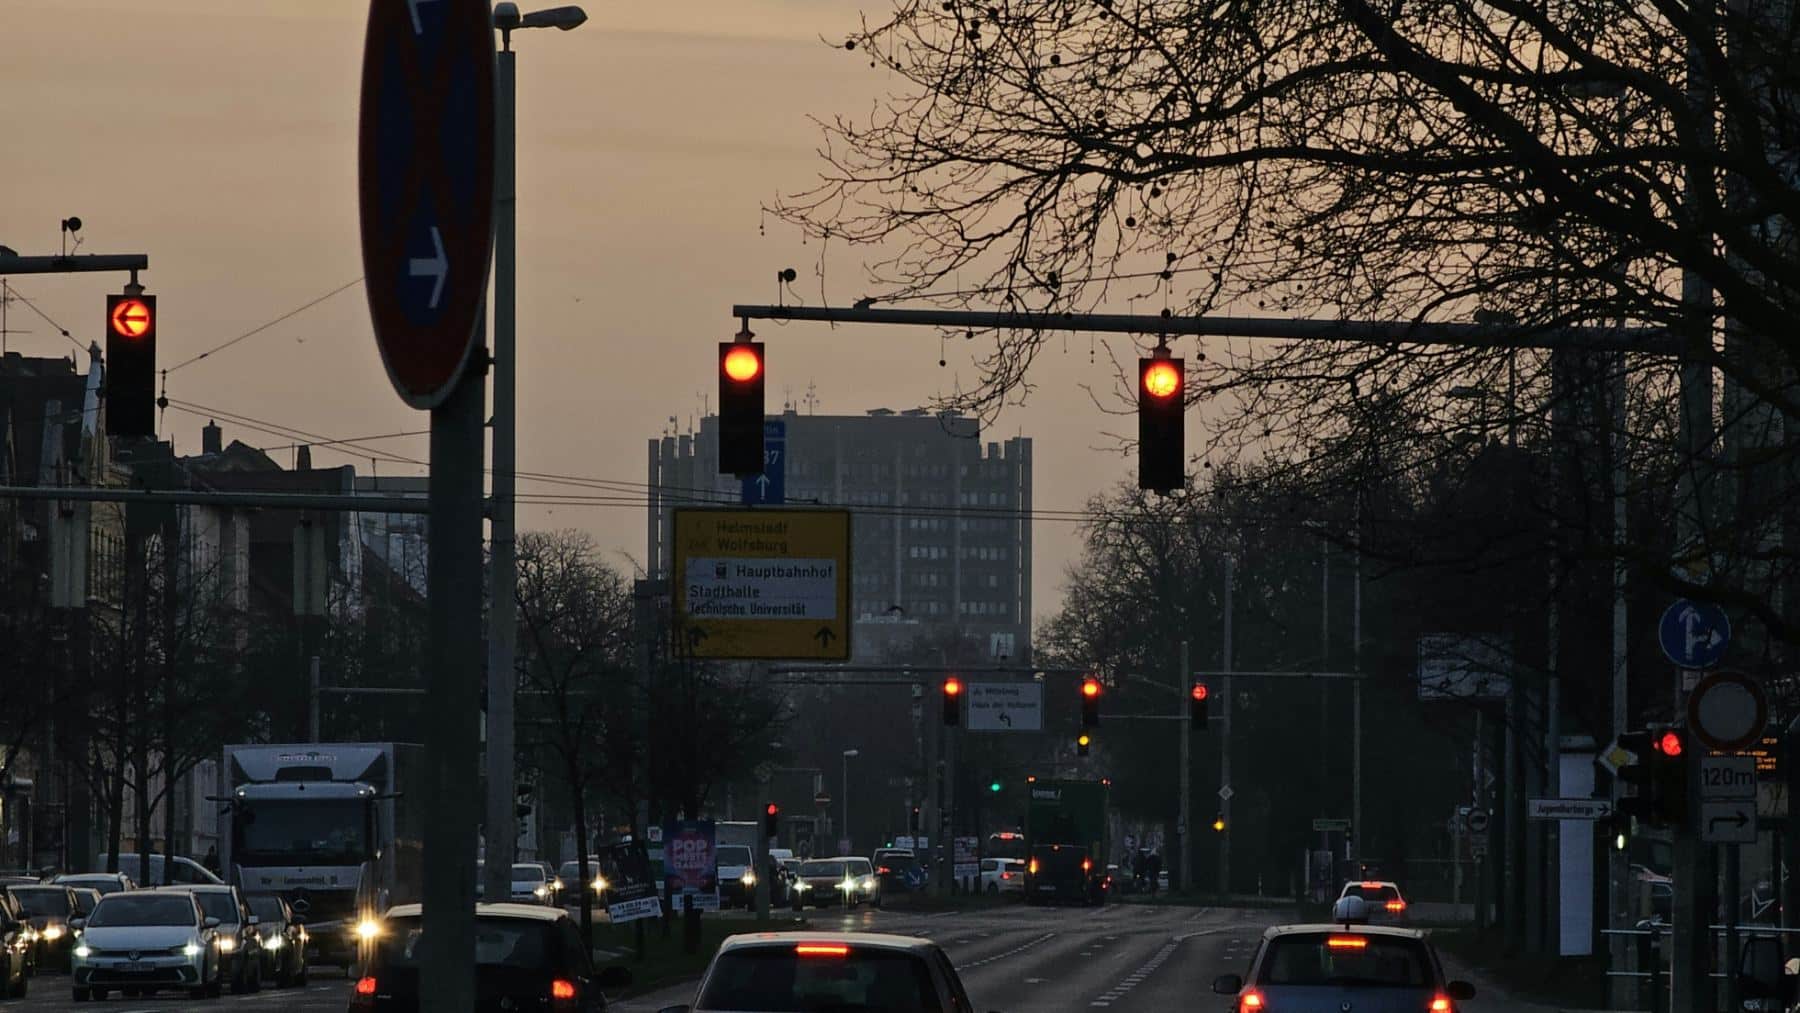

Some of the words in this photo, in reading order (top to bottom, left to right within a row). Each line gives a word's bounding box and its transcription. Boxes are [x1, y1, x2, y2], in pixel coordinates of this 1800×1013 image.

[717, 537, 788, 554] Wolfsburg
[736, 563, 834, 580] Hauptbahnhof
[689, 584, 761, 599] Stadthalle
[689, 602, 746, 617] Technische
[750, 602, 807, 617] Universität
[1702, 767, 1753, 785] 120m
[672, 839, 707, 852] POP
